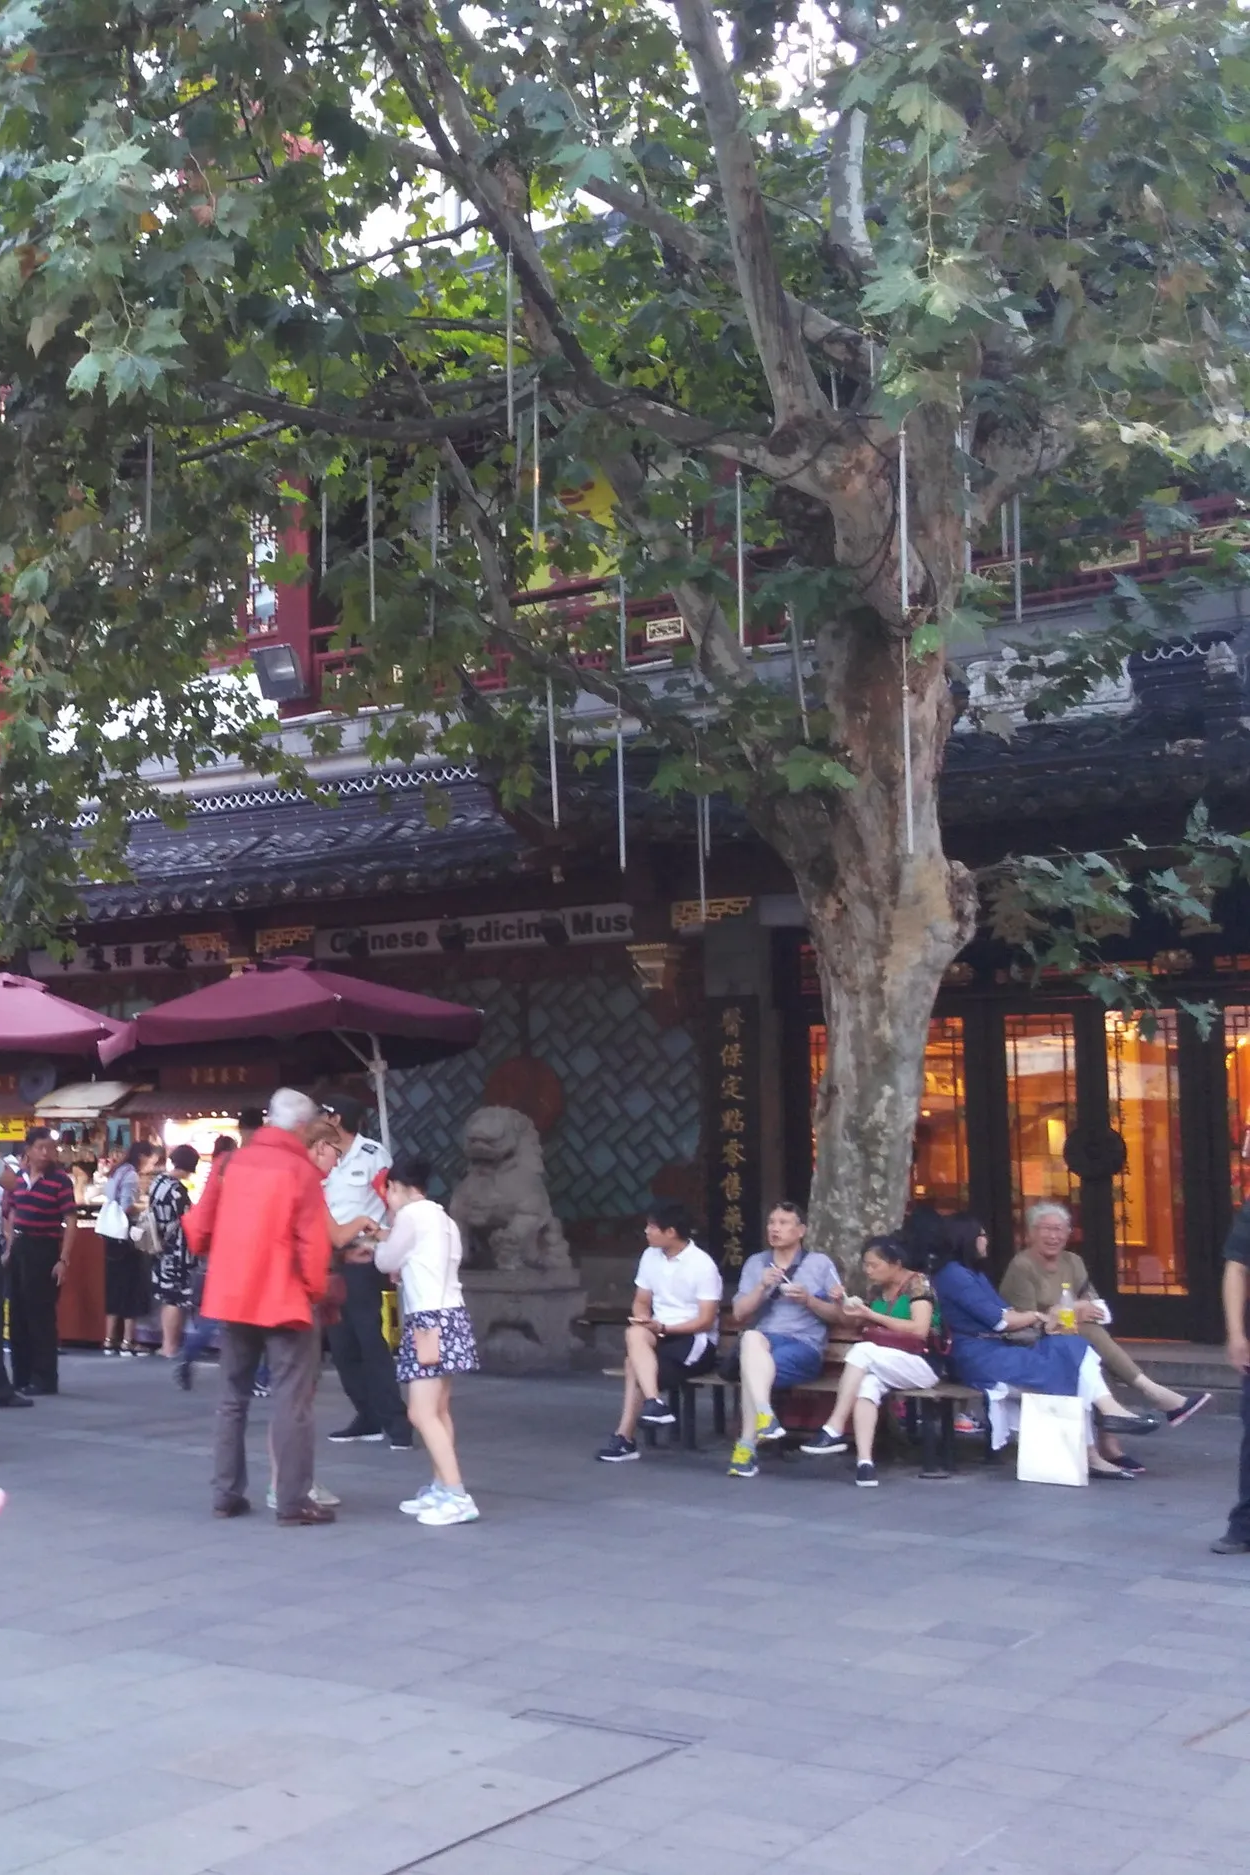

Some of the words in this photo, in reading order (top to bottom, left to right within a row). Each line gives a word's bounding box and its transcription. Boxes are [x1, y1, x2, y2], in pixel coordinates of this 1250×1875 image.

[329, 926, 429, 955] Cinese
[440, 914, 556, 949] edicin
[571, 910, 634, 936] Mus
